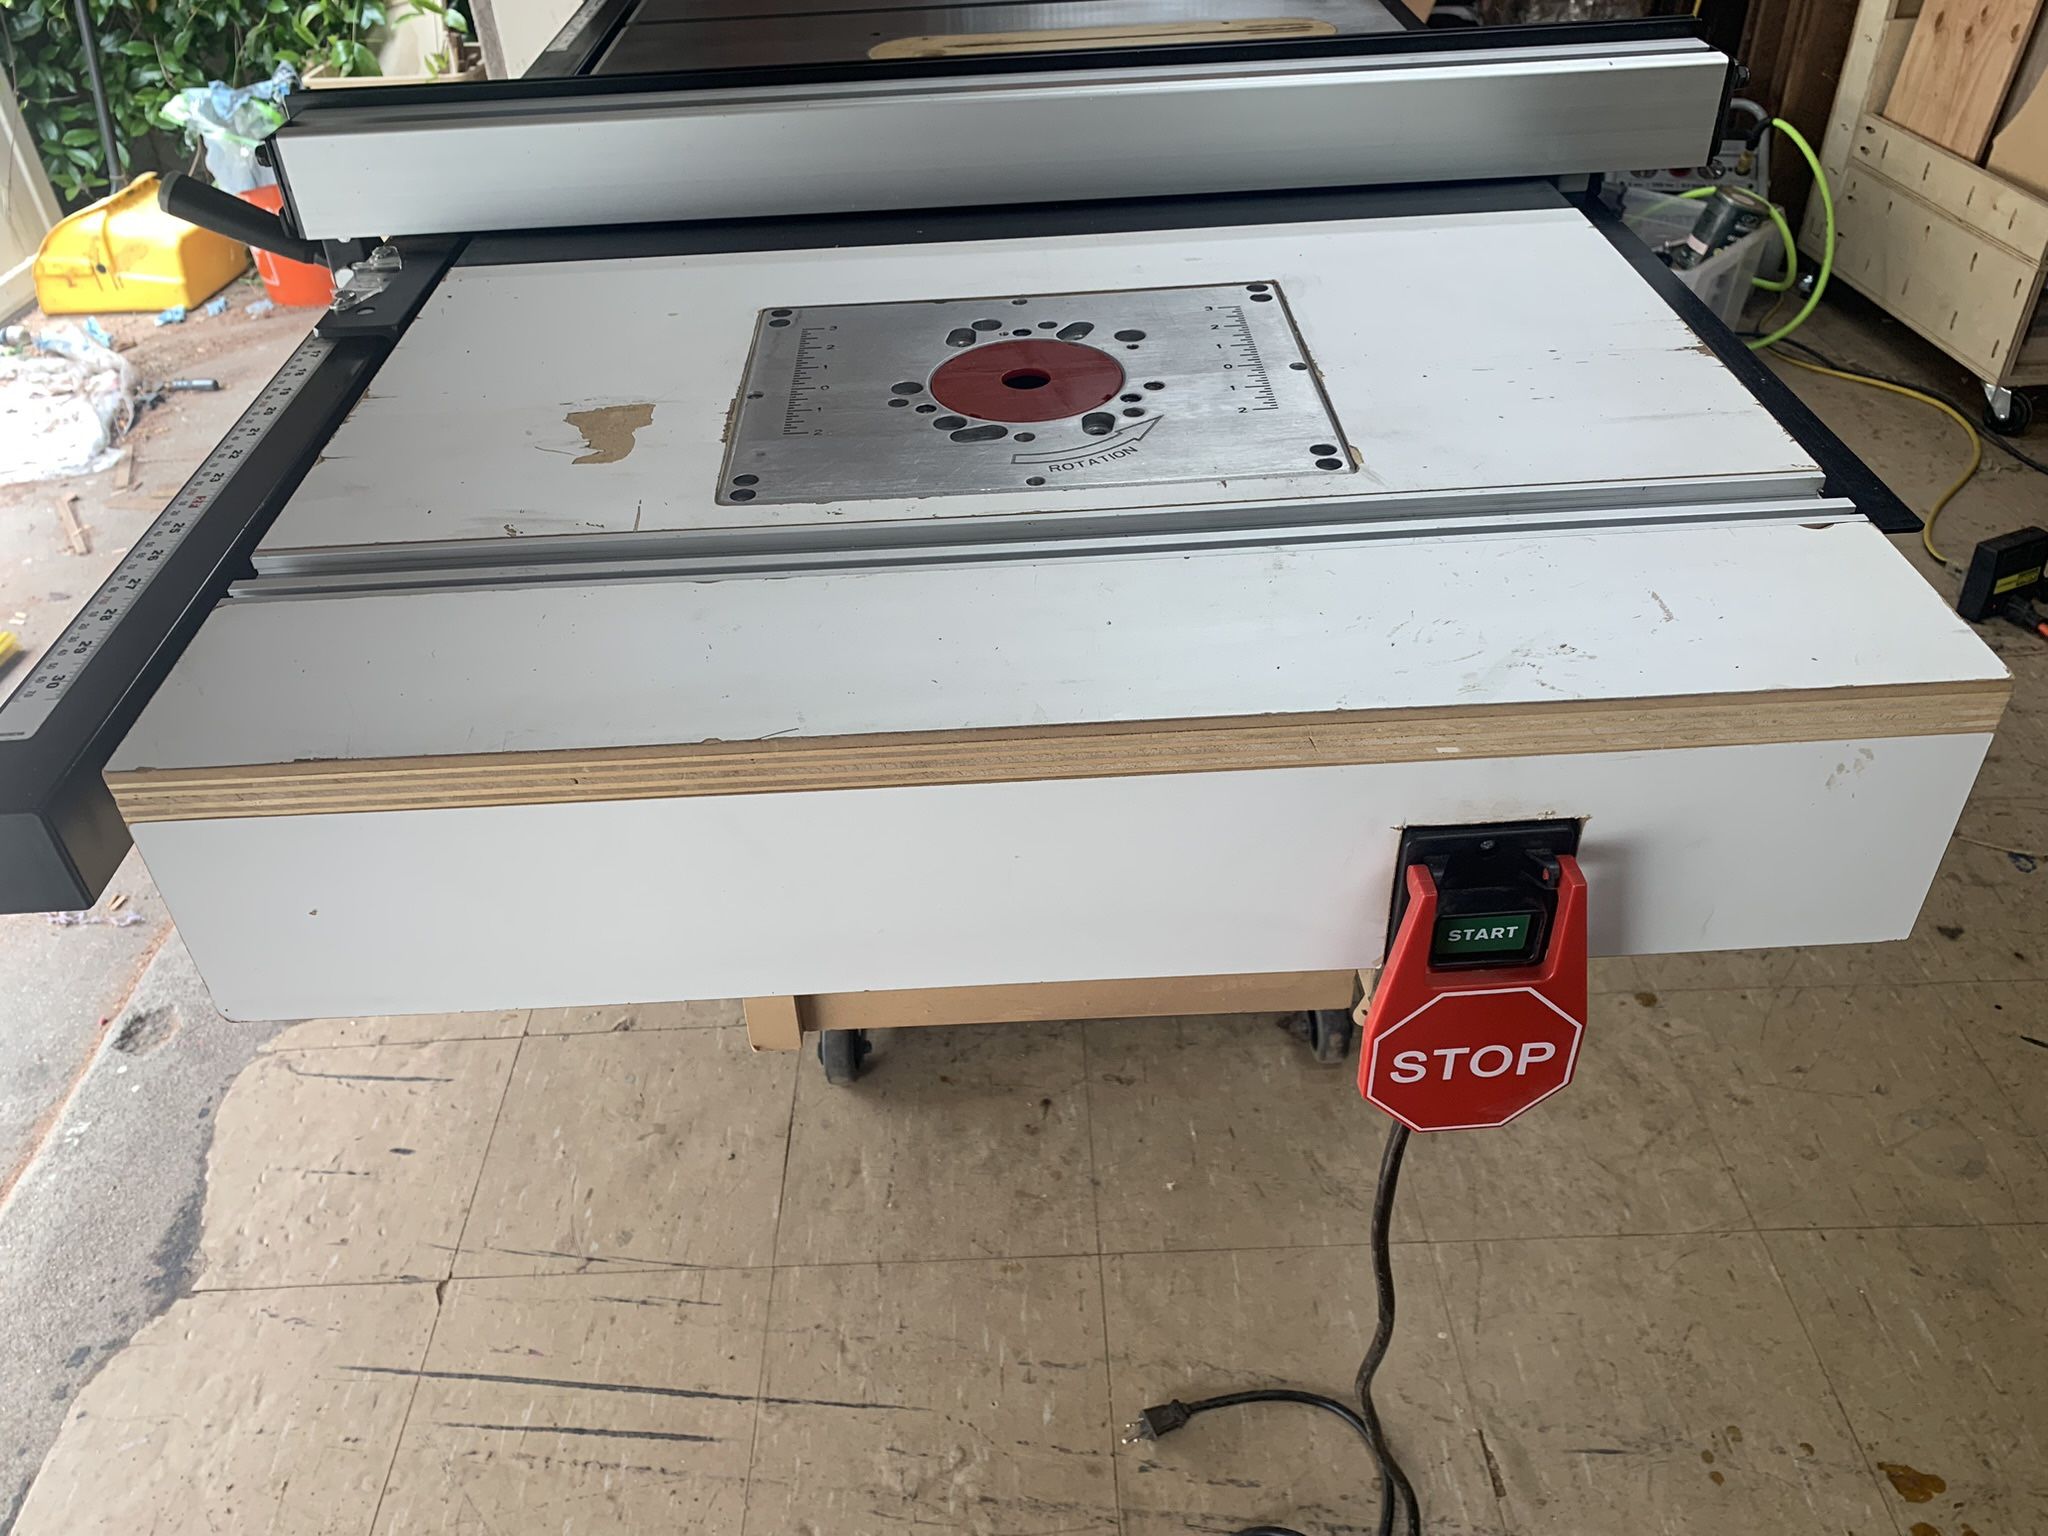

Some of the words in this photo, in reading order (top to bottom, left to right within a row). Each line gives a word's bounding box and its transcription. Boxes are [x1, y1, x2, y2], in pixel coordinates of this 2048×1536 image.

[263, 406, 277, 416] 20
[246, 427, 260, 437] 21
[228, 449, 243, 460] 22
[1048, 446, 1138, 473] ROTATION
[209, 472, 225, 483] 23
[169, 522, 186, 533] 25
[147, 549, 164, 561] 26
[125, 578, 142, 590] 27
[99, 608, 118, 622] 28
[73, 640, 93, 654] 29
[45, 674, 66, 689] 30
[1448, 925, 1519, 942] START
[1390, 1041, 1557, 1084] STOP
